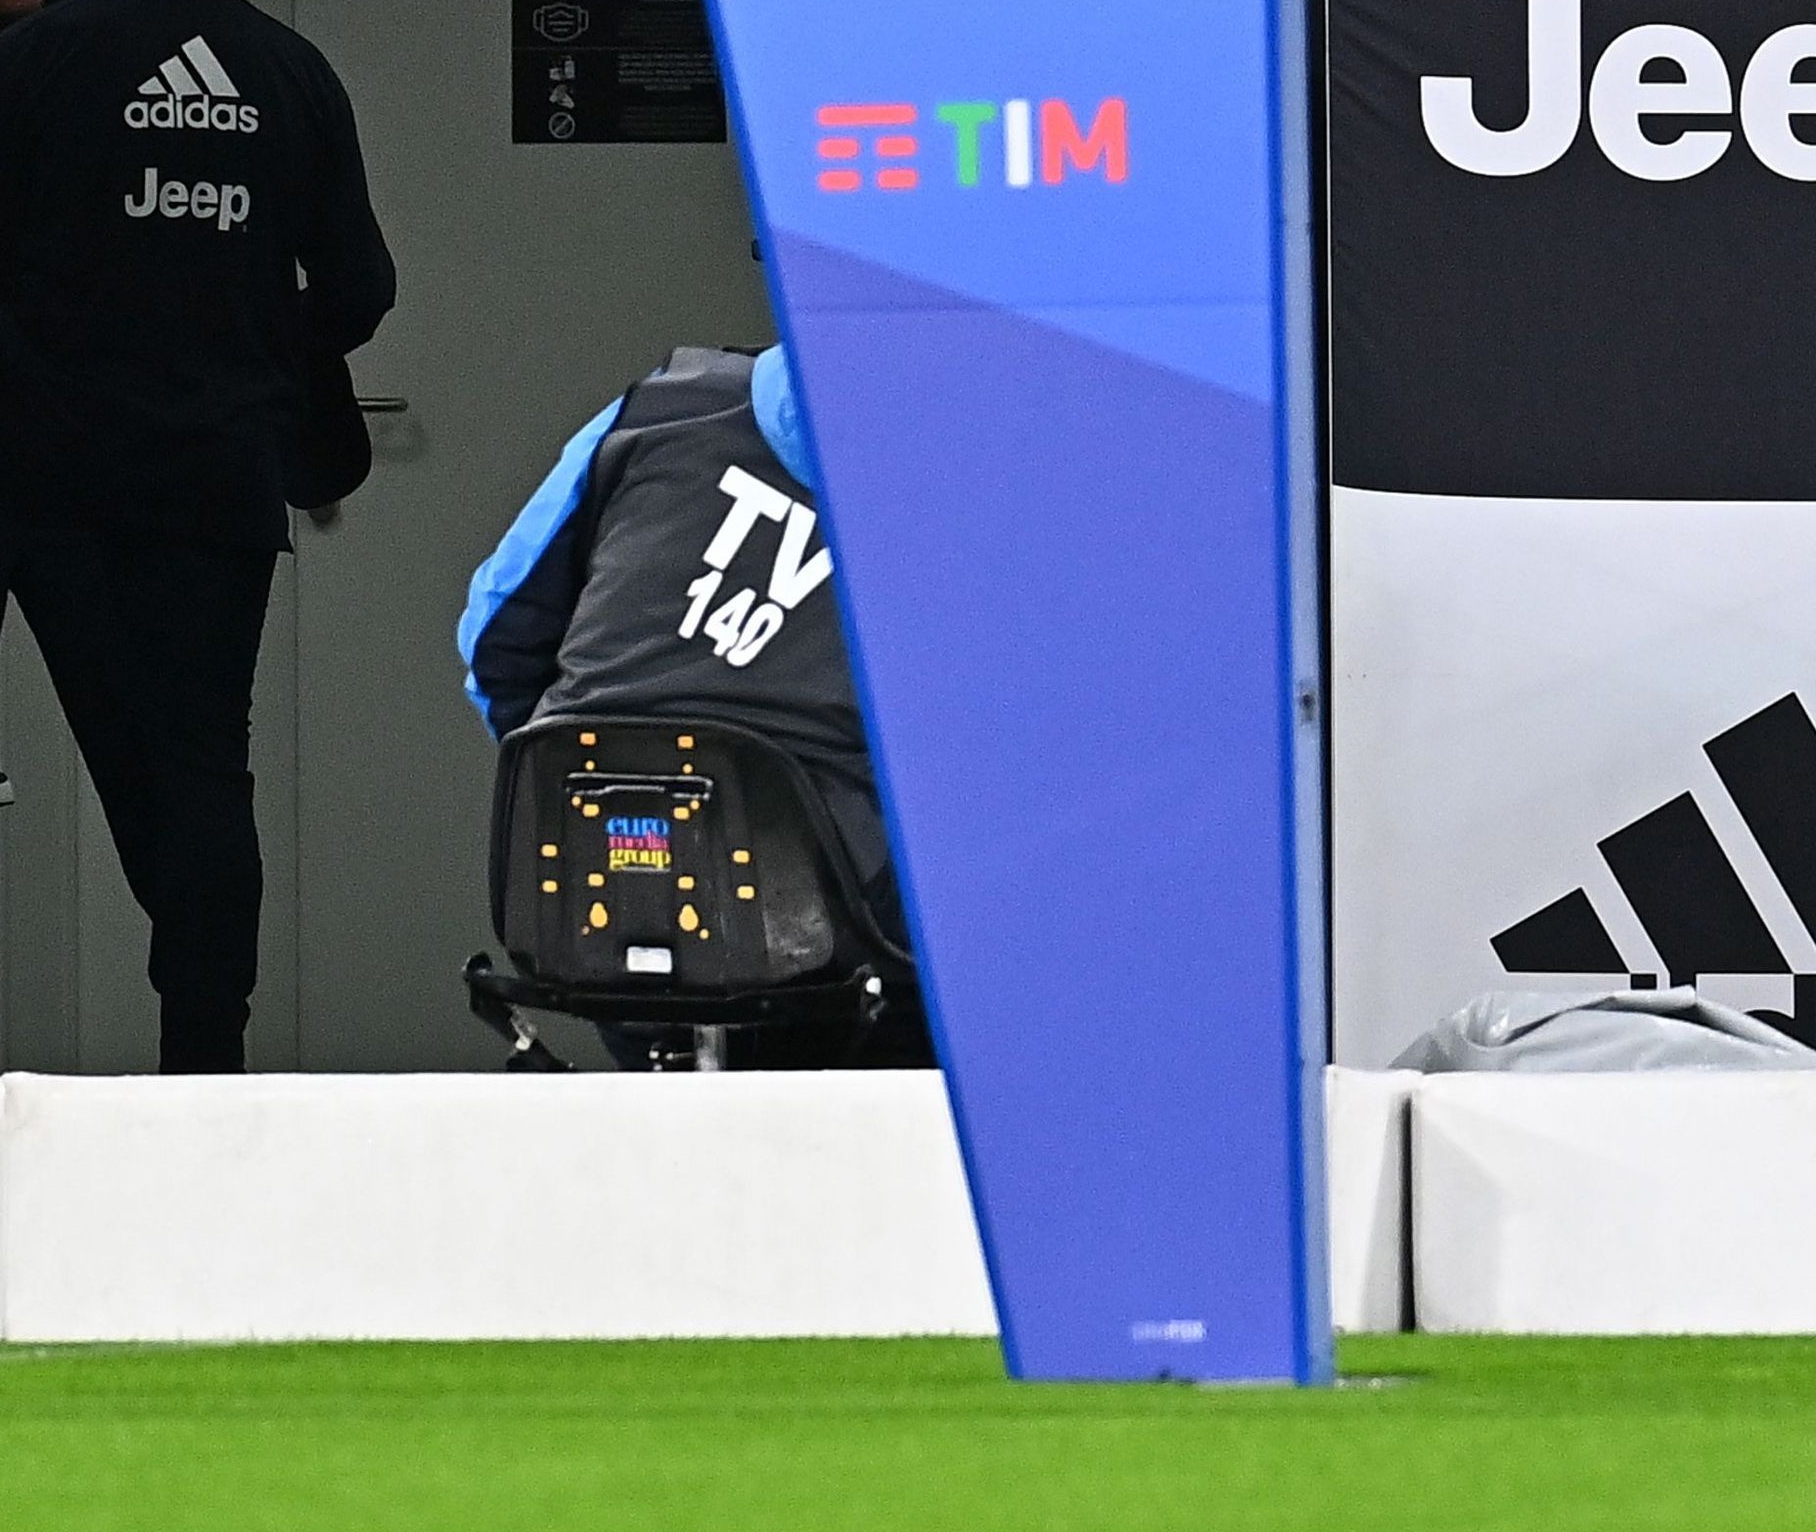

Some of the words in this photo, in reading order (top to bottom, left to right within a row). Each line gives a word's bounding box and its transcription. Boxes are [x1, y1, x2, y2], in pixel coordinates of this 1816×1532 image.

[124, 95, 259, 133] adidas
[936, 97, 1127, 187] TIM
[124, 167, 251, 231] Jeep
[703, 465, 834, 609] TV
[678, 570, 784, 666] 140
[606, 816, 671, 836] euro
[609, 848, 672, 871] group
